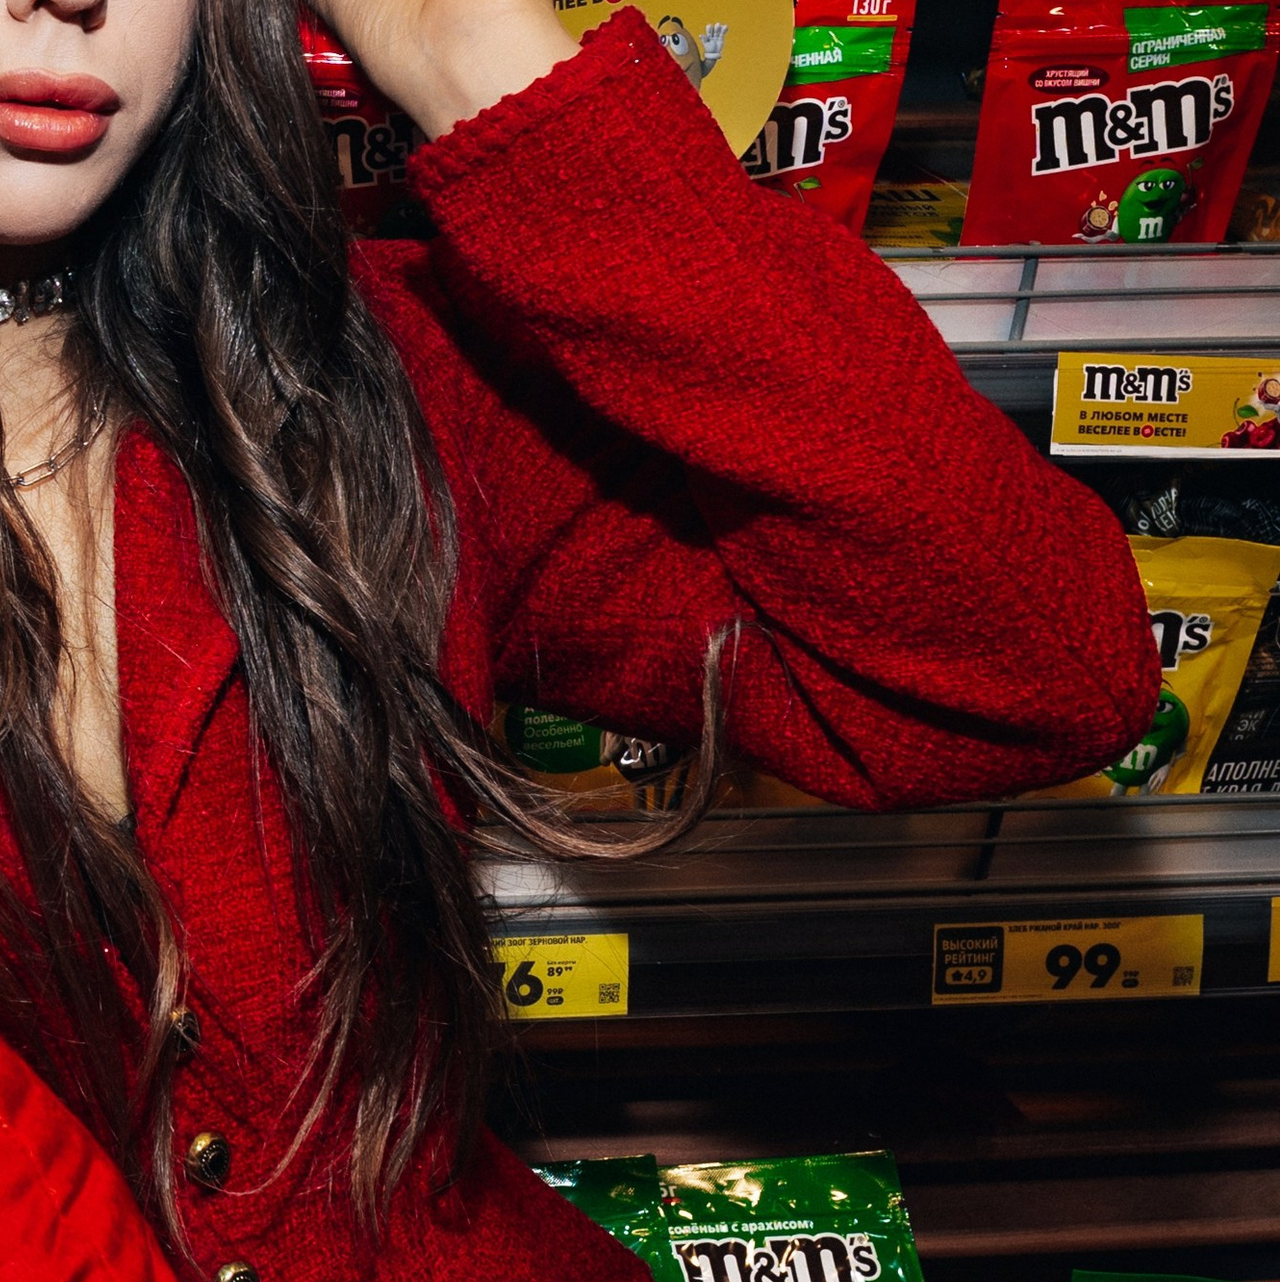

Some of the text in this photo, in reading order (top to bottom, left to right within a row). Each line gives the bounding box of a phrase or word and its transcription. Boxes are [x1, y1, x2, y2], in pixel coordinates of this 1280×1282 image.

[1132, 27, 1227, 55] ОГРАНИЧЕННАЯ
[1130, 53, 1171, 71] СЕРИЯ
[1045, 68, 1089, 79] ХРУСТЯЩИЙ
[1137, 217, 1164, 240] m
[1079, 410, 1189, 423] В ЛЮБОМ МЕСТЕ
[1078, 424, 1131, 436] ВЕСЕЛЕЕ
[524, 723, 584, 739] Особенно
[1029, 922, 1062, 933] РЖАНОЙ
[528, 936, 569, 946] ЗЕРНОВОЙ
[942, 937, 998, 951] ВЫСОКИЙ
[944, 950, 995, 965] РЕЙТИНГ
[1045, 942, 1121, 990] 99
[741, 1218, 810, 1235] арахисом
